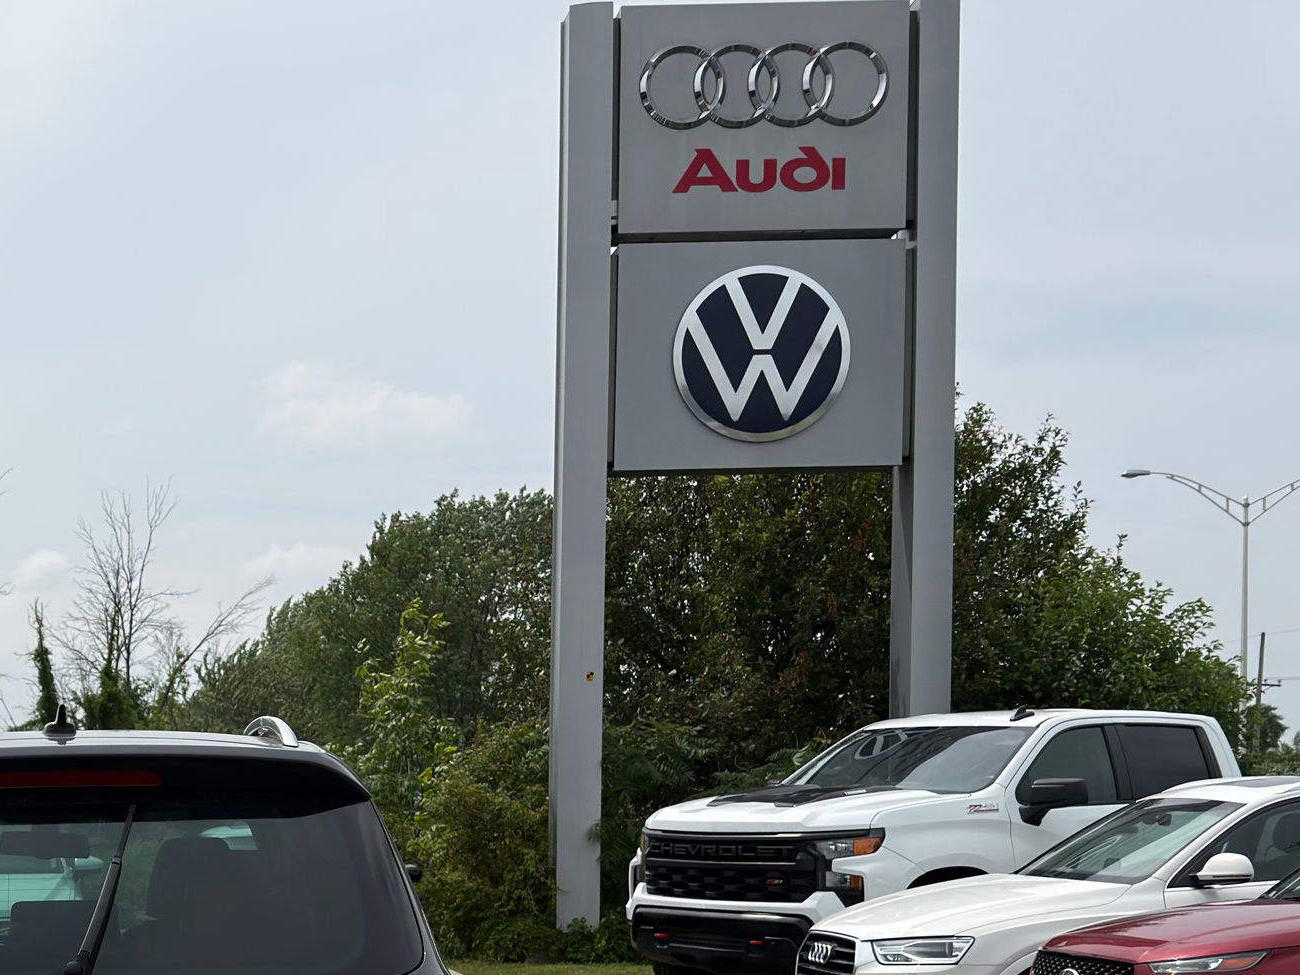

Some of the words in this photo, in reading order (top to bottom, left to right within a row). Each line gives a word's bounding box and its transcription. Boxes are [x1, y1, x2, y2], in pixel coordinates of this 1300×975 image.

[672, 146, 846, 193] Audi
[675, 267, 849, 435] VW
[651, 842, 795, 858] CHEVROLET
